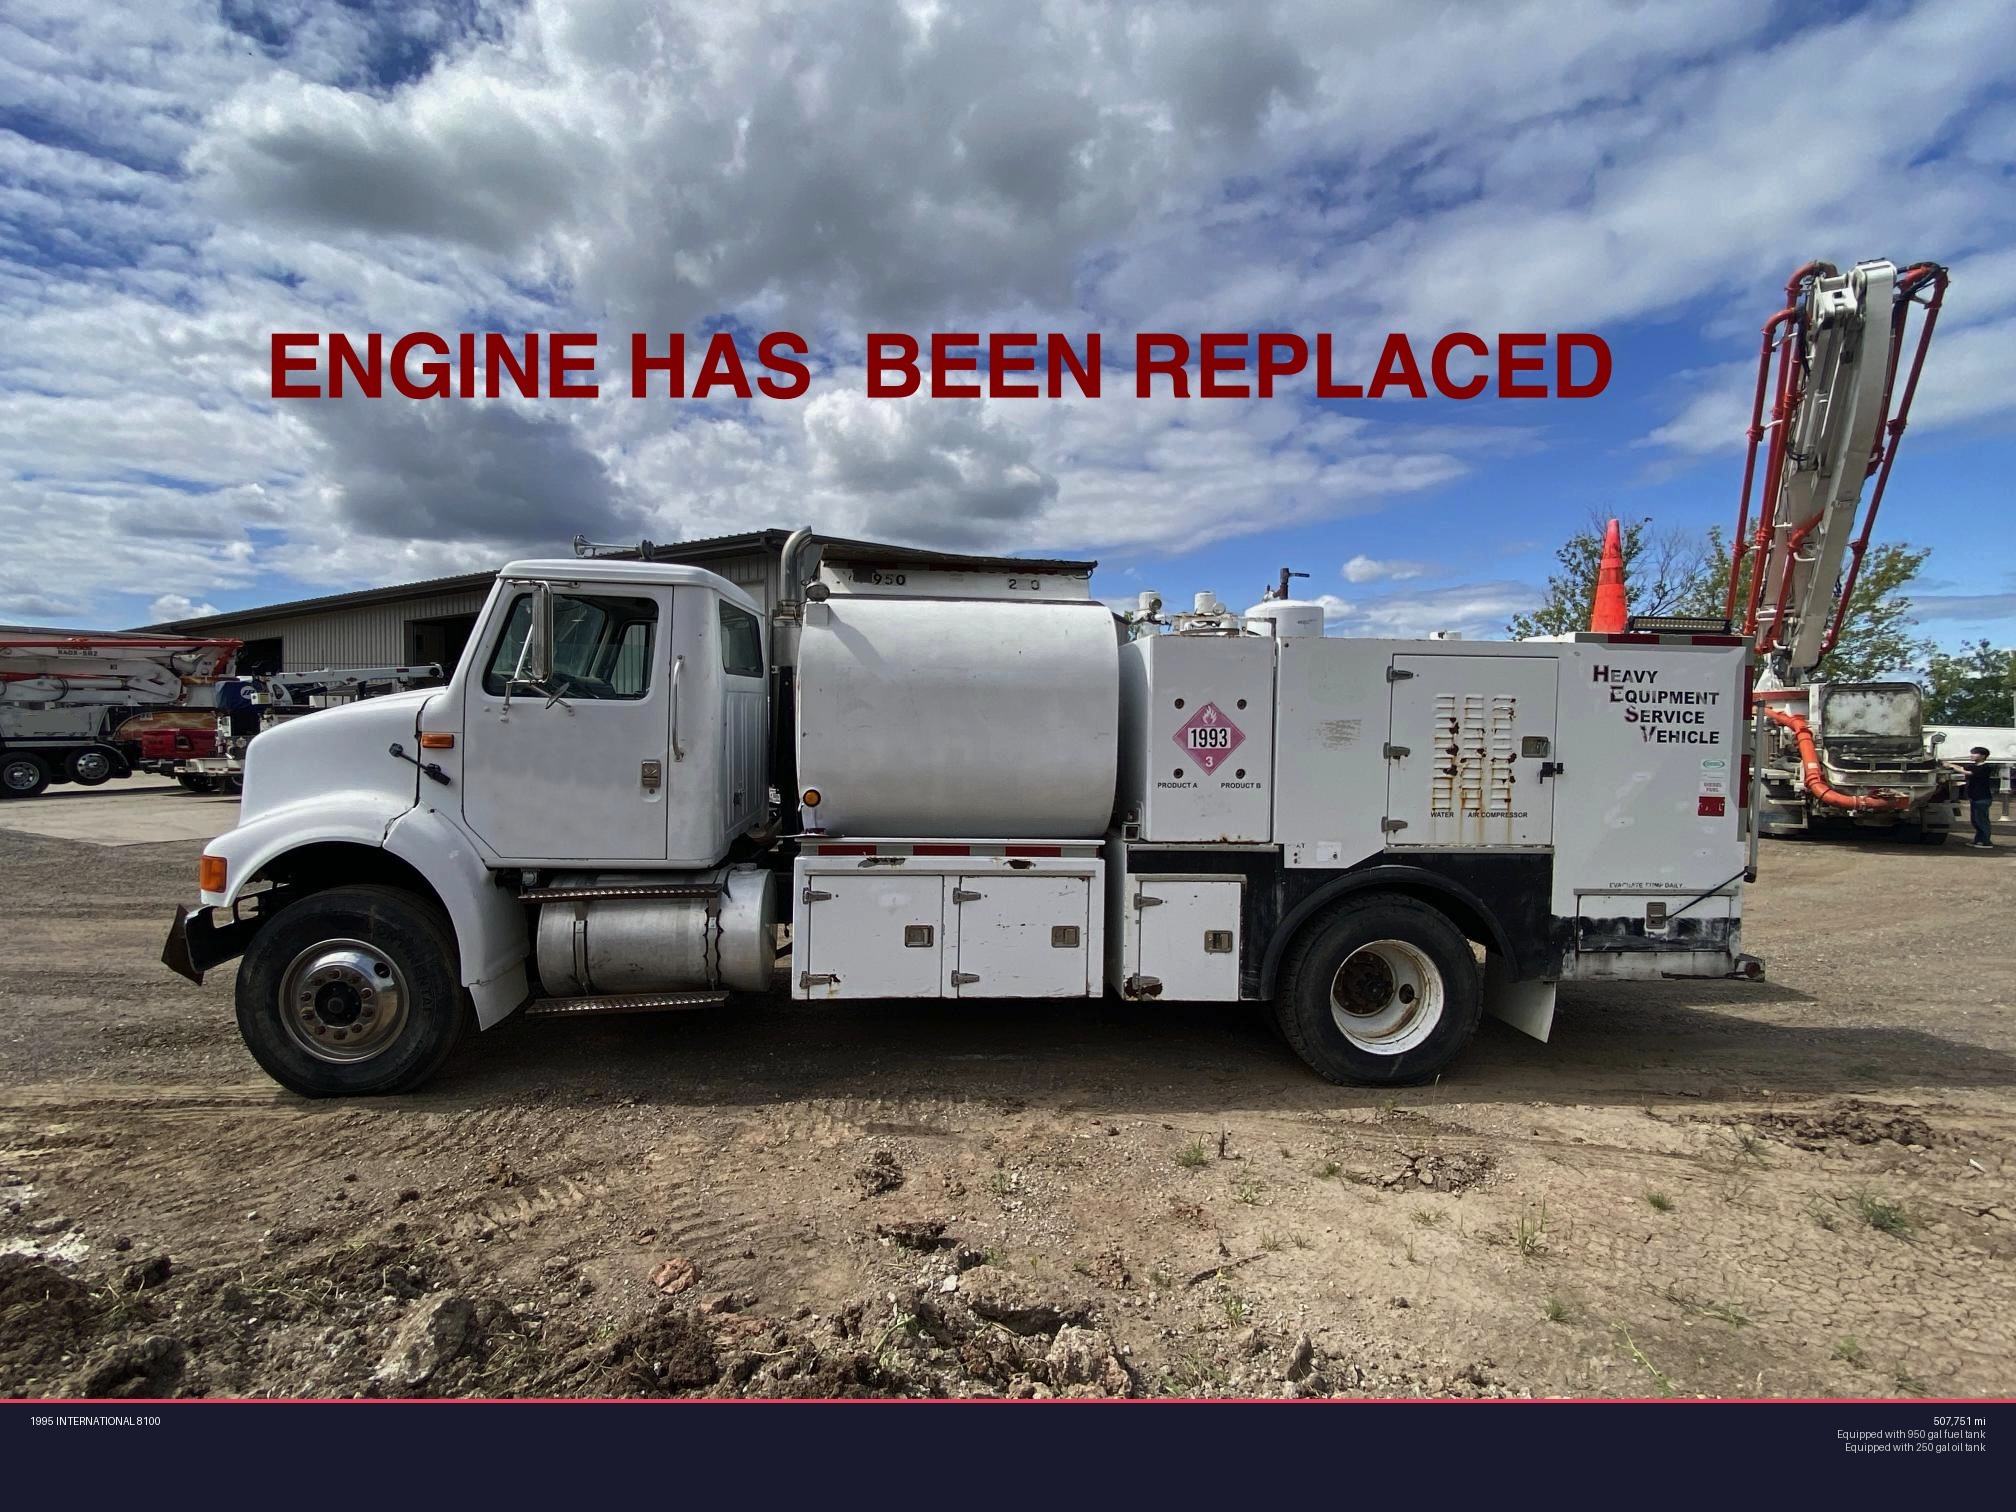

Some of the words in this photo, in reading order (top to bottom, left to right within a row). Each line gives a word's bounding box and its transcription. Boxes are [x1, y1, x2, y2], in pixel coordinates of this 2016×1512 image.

[873, 573, 906, 586] 950
[1593, 665, 1658, 683] HEAVY
[1610, 685, 1720, 705] EQUIPMENT
[1624, 705, 1705, 724] SERVICE
[1190, 728, 1228, 748] 1993
[1640, 725, 1720, 745] VEHICLE
[1205, 756, 1214, 768] 3
